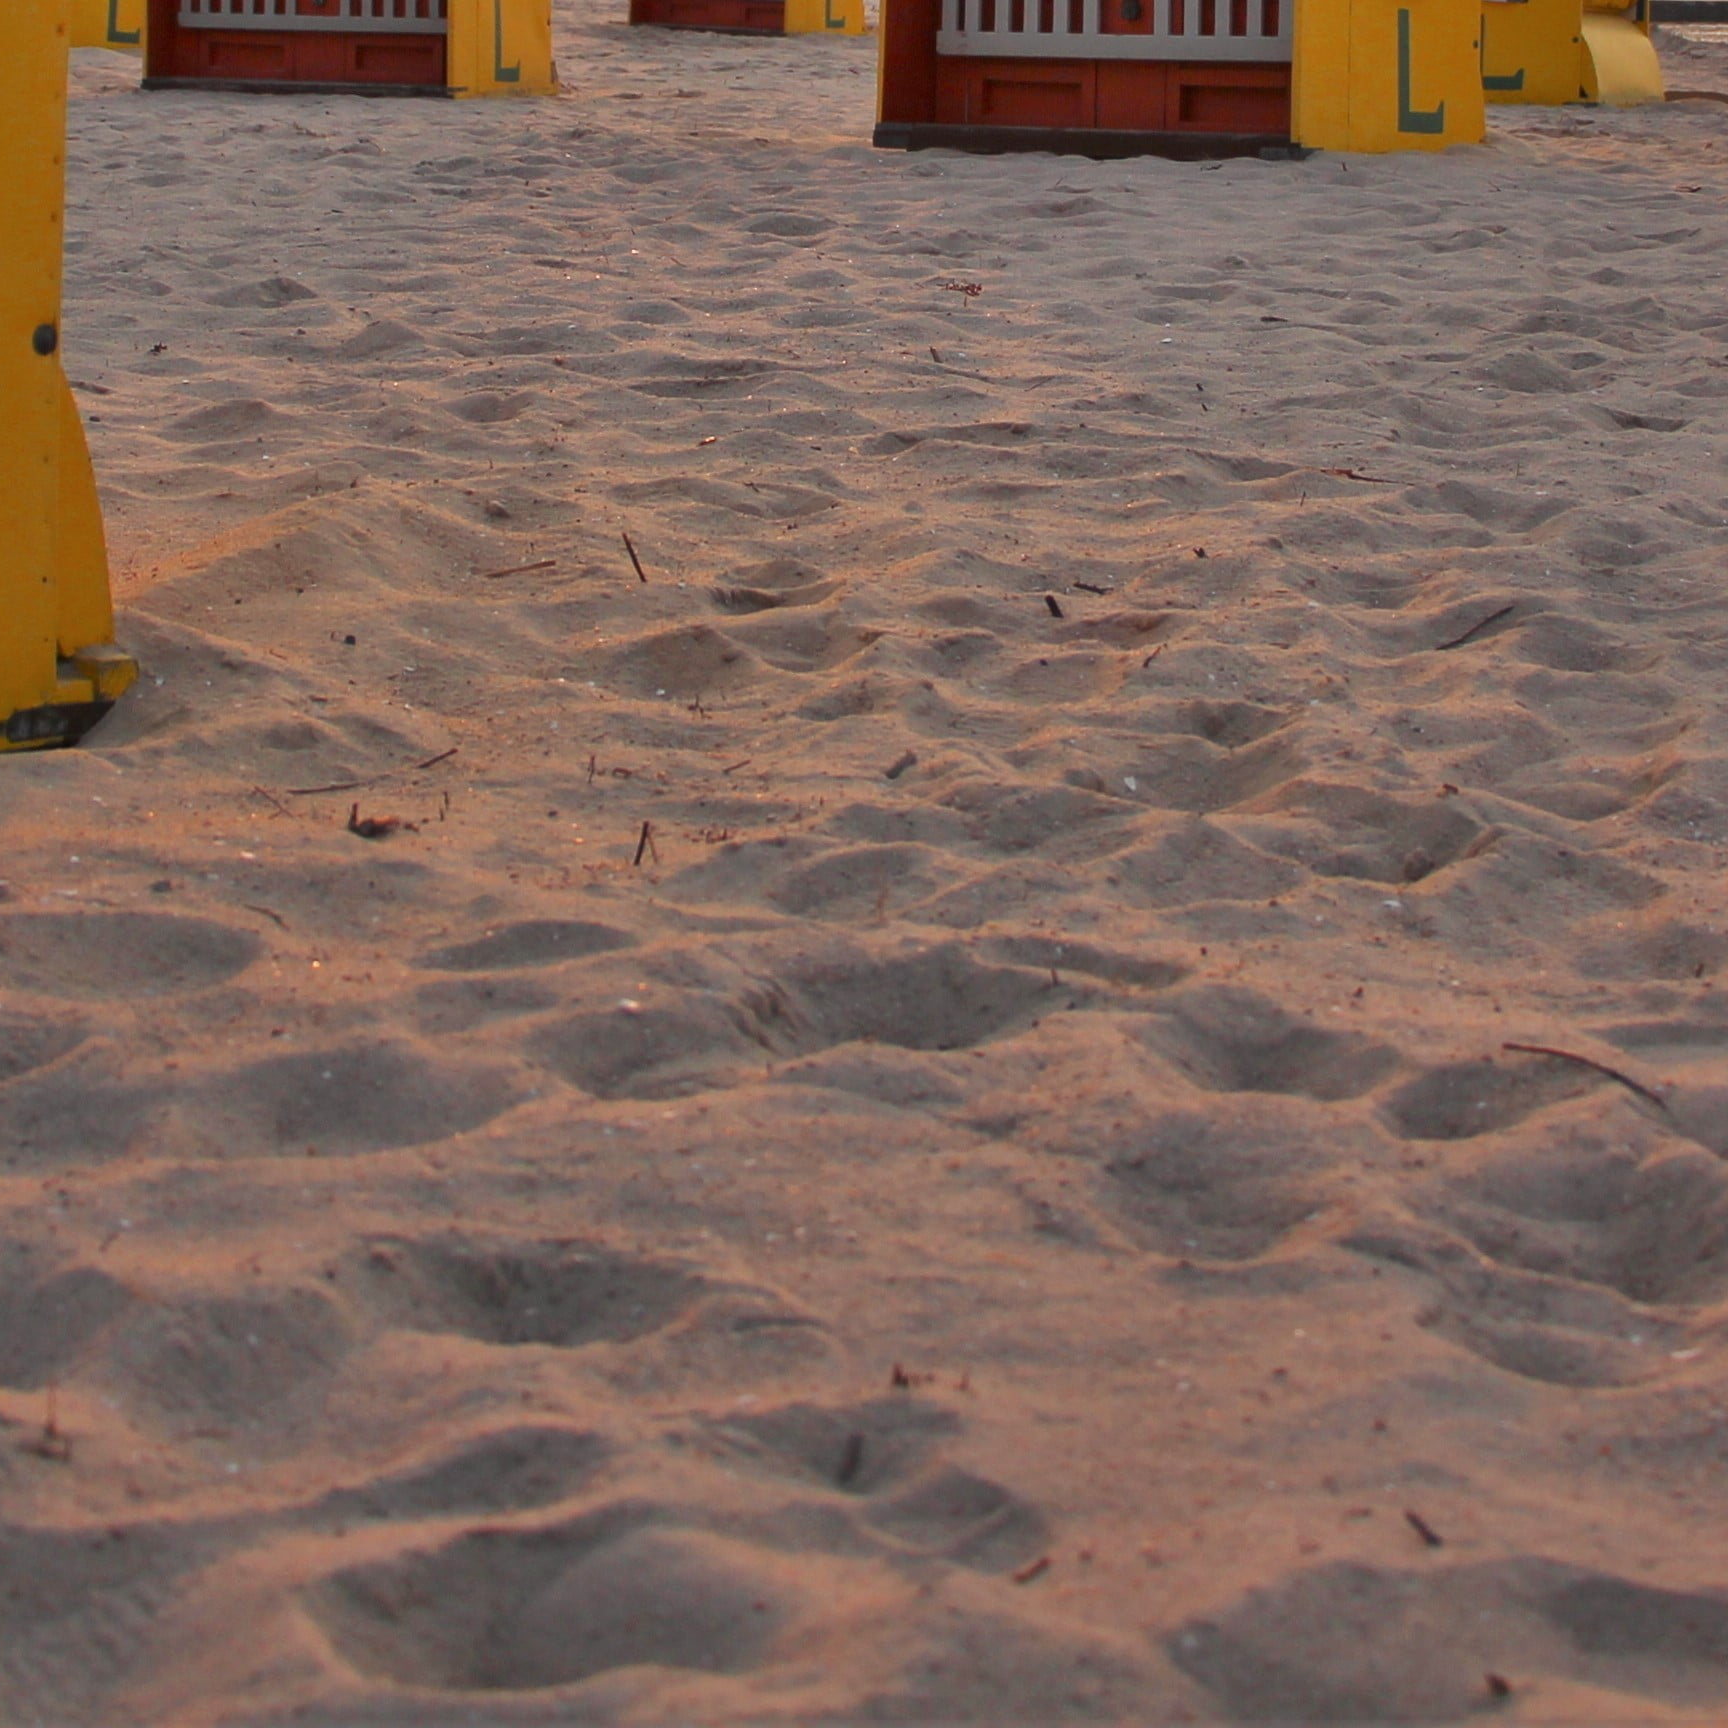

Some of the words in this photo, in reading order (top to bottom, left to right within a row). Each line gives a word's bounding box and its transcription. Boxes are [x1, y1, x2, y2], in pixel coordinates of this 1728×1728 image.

[494, 0, 521, 83] L
[1397, 8, 1444, 134] L
[1480, 13, 1525, 91] L
